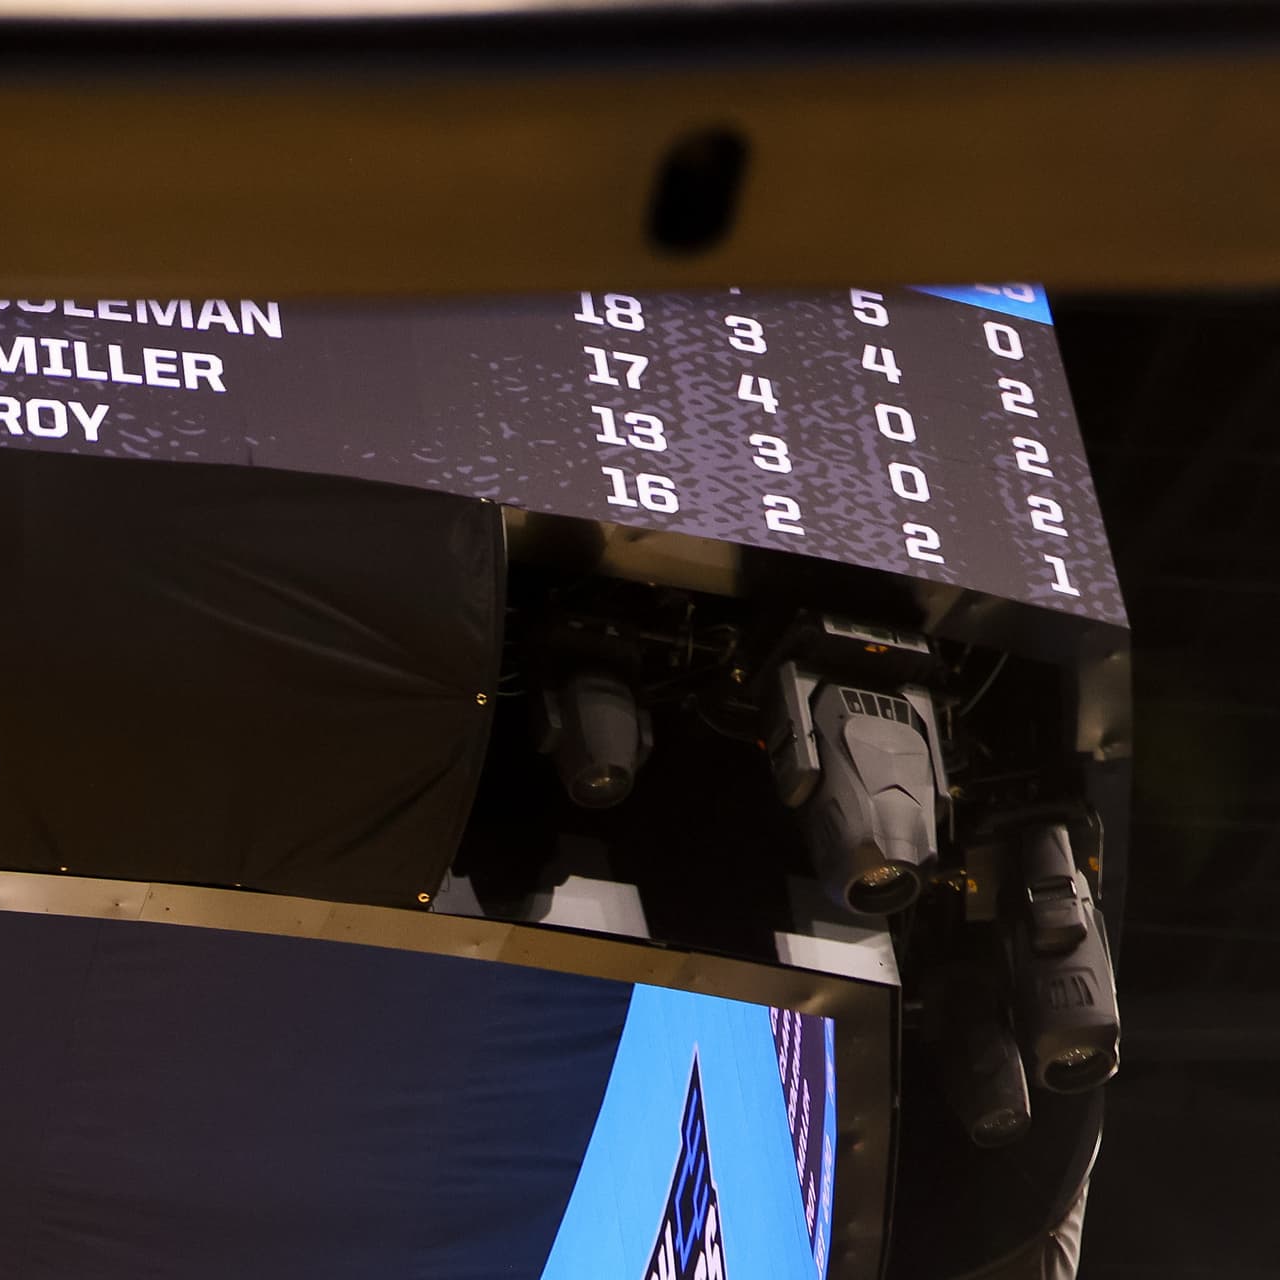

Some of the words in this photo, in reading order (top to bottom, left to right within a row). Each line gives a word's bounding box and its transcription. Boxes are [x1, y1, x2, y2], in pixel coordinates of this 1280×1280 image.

[574, 291, 646, 331] 18
[724, 315, 768, 354] 3
[862, 344, 903, 384] 4
[997, 377, 1039, 418] 2
[850, 289, 890, 327] 5
[983, 321, 1025, 361] 0
[582, 346, 650, 390] 17
[738, 375, 779, 414] 4
[875, 403, 917, 444] 0
[1012, 437, 1055, 478] 2
[591, 406, 669, 453] 13
[749, 433, 793, 474] 3
[889, 462, 931, 502] 0
[1026, 495, 1069, 537] 2
[601, 467, 680, 515] 16
[762, 495, 806, 537] 2
[902, 522, 945, 565] 2
[1042, 555, 1081, 597] 1
